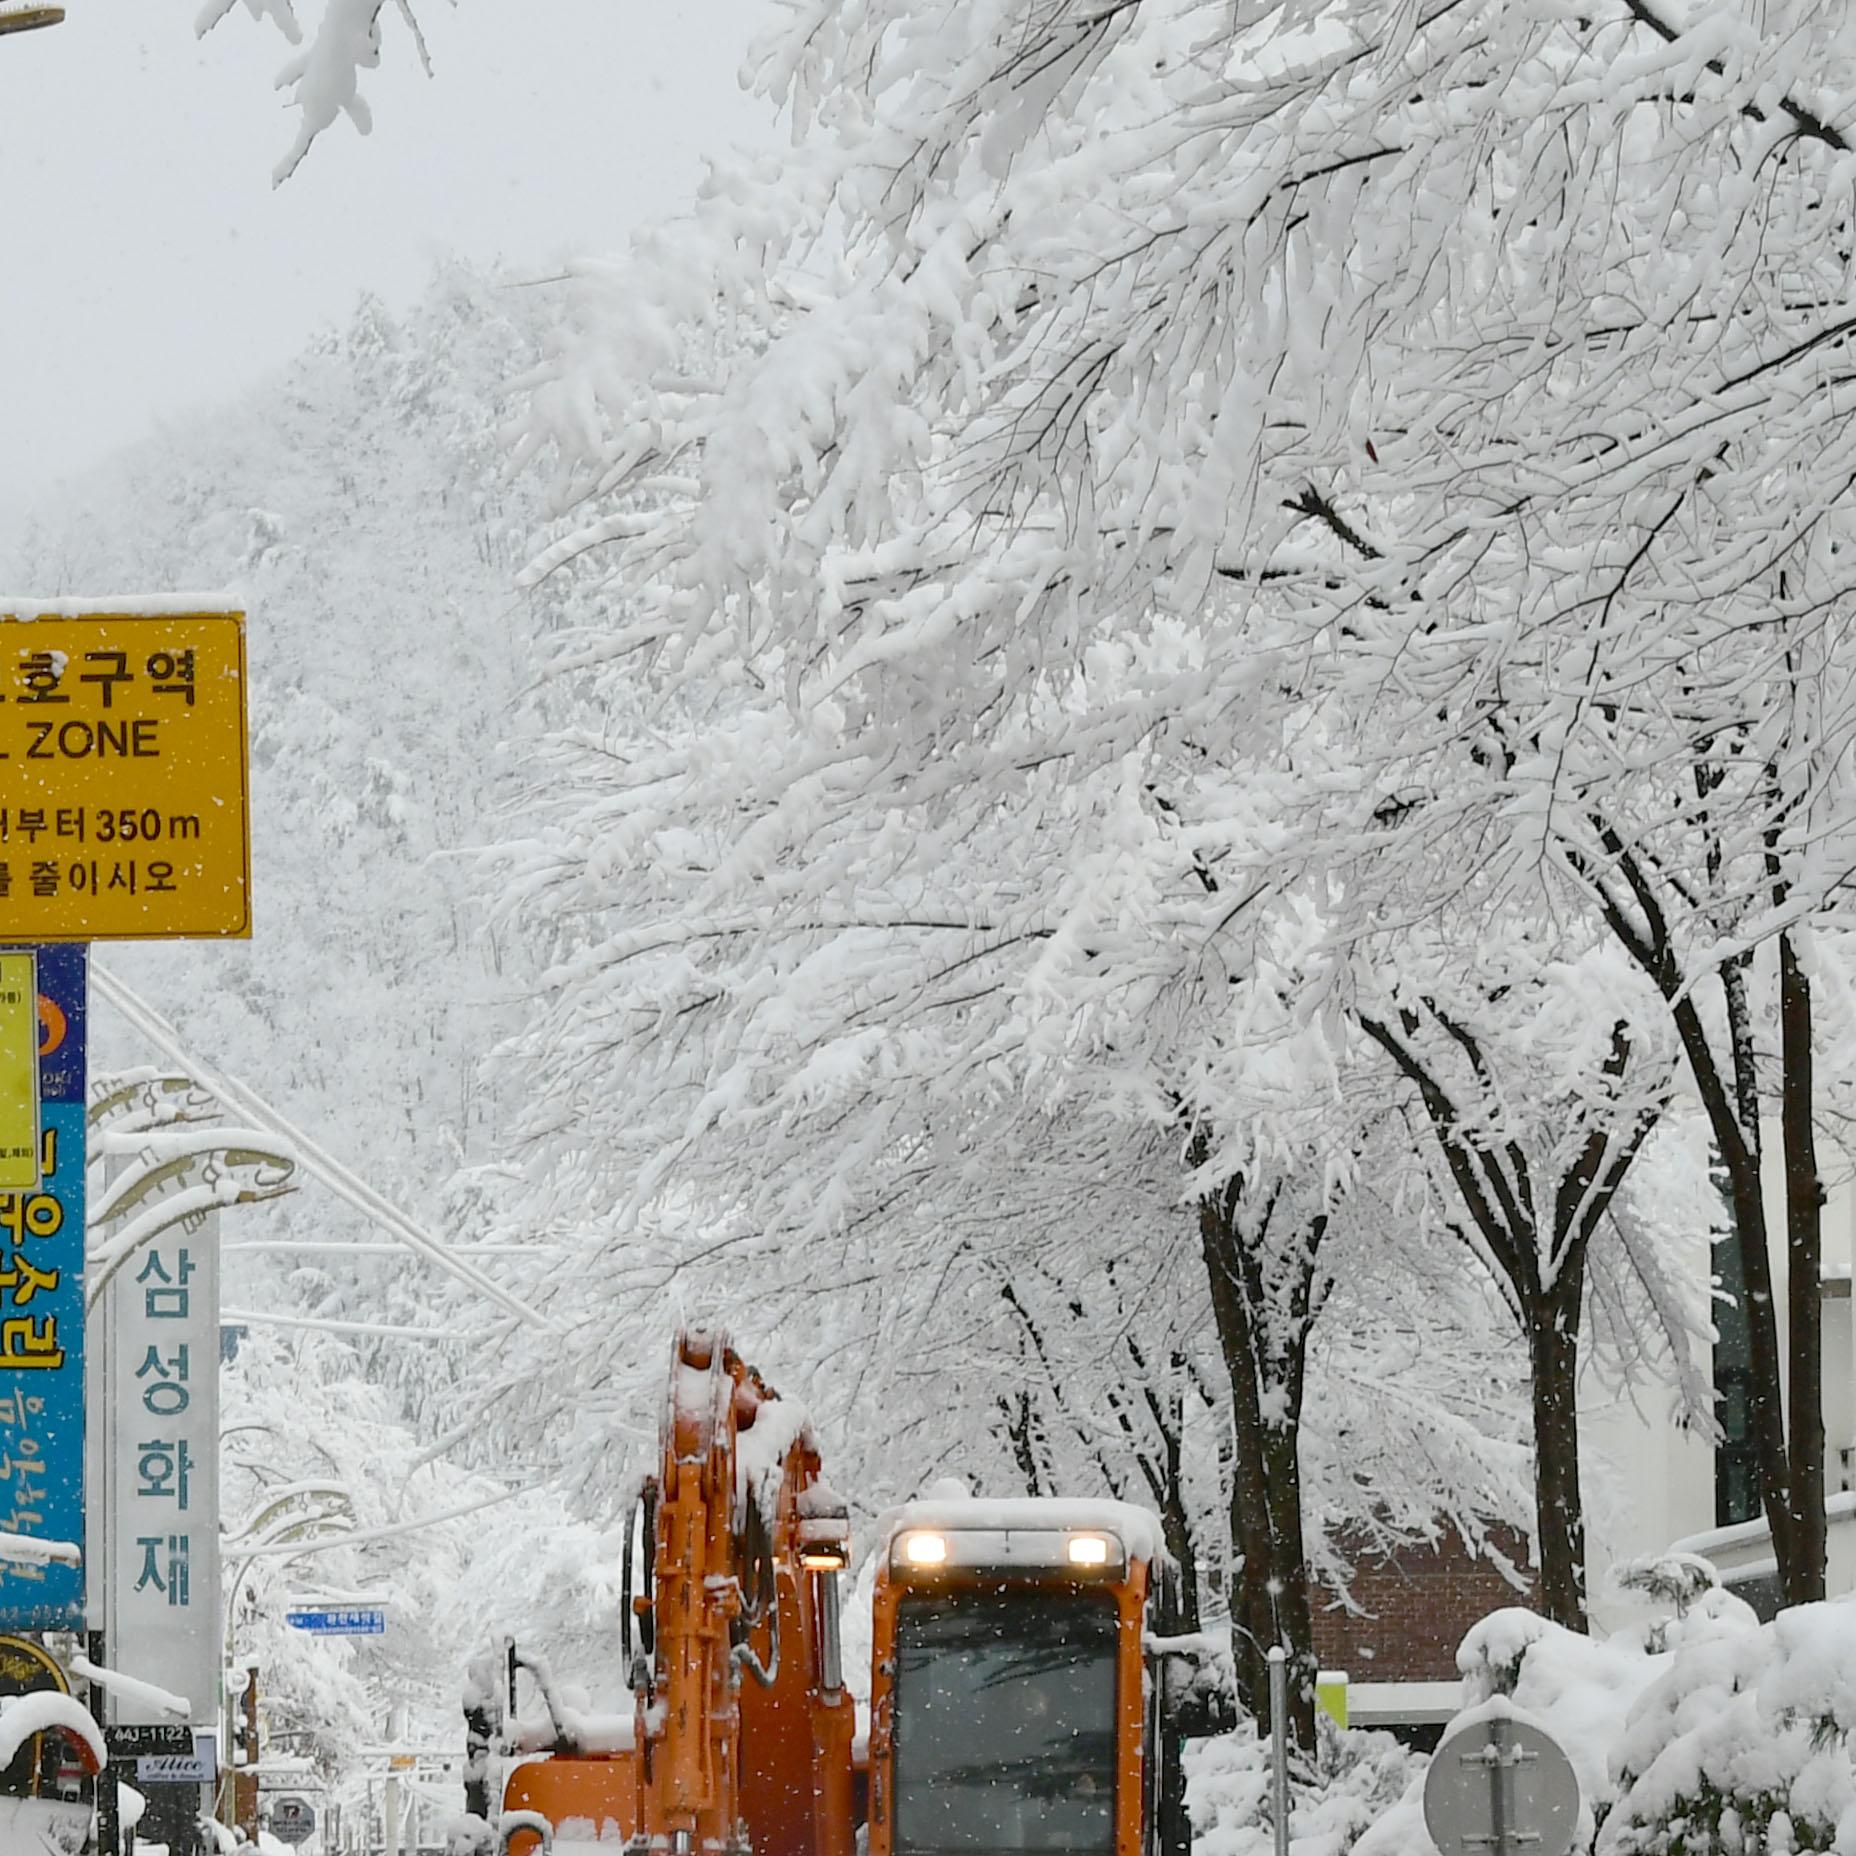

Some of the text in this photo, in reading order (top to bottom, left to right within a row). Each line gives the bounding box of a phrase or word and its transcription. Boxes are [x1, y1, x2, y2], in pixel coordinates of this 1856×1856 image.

[25, 719, 160, 759] ZONE
[27, 859, 178, 896] 줄이시오
[135, 1247, 195, 1607] 삼성화재
